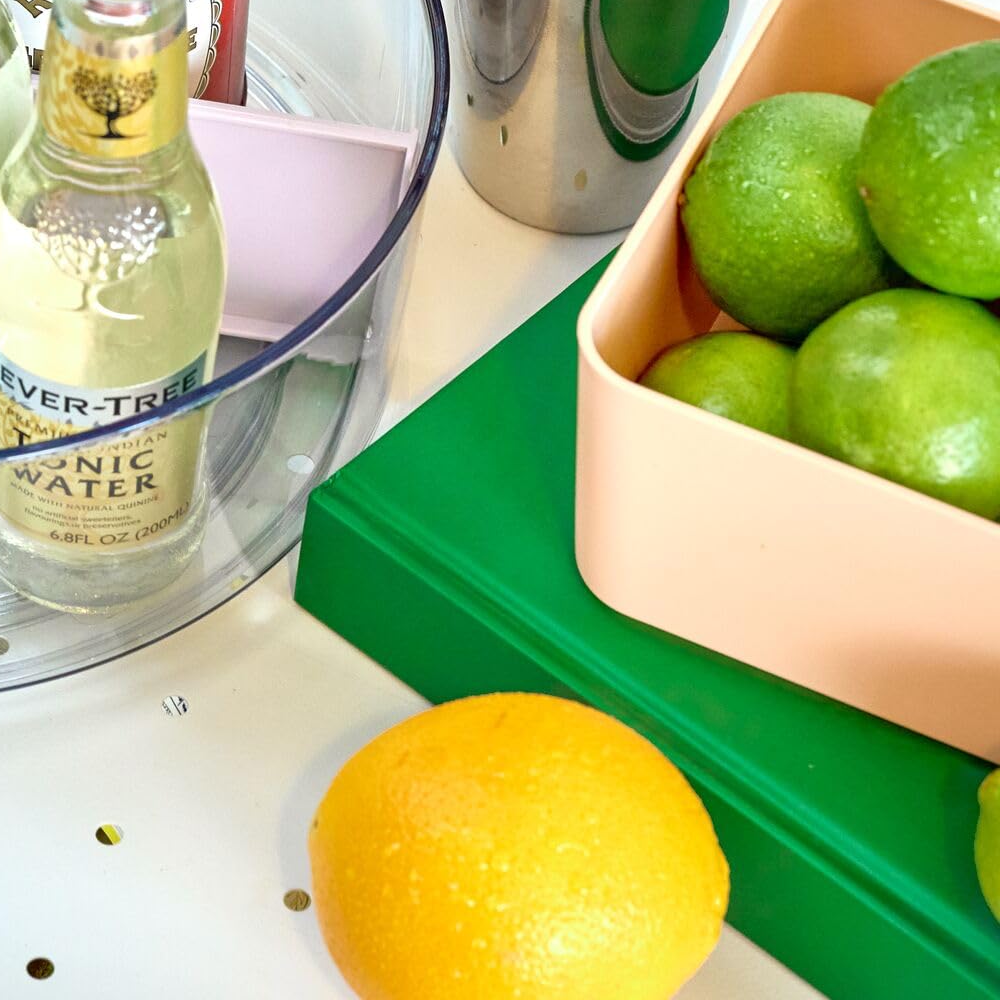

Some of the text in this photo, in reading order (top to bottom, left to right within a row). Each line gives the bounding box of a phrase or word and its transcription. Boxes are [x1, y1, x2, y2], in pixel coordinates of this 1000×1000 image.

[13, 466, 160, 499] WATER
[37, 495, 63, 508] WITH
[66, 503, 114, 512] NATURAL
[117, 495, 160, 511] QUININE
[50, 501, 190, 545] 6.8FL OZ (200ML)
